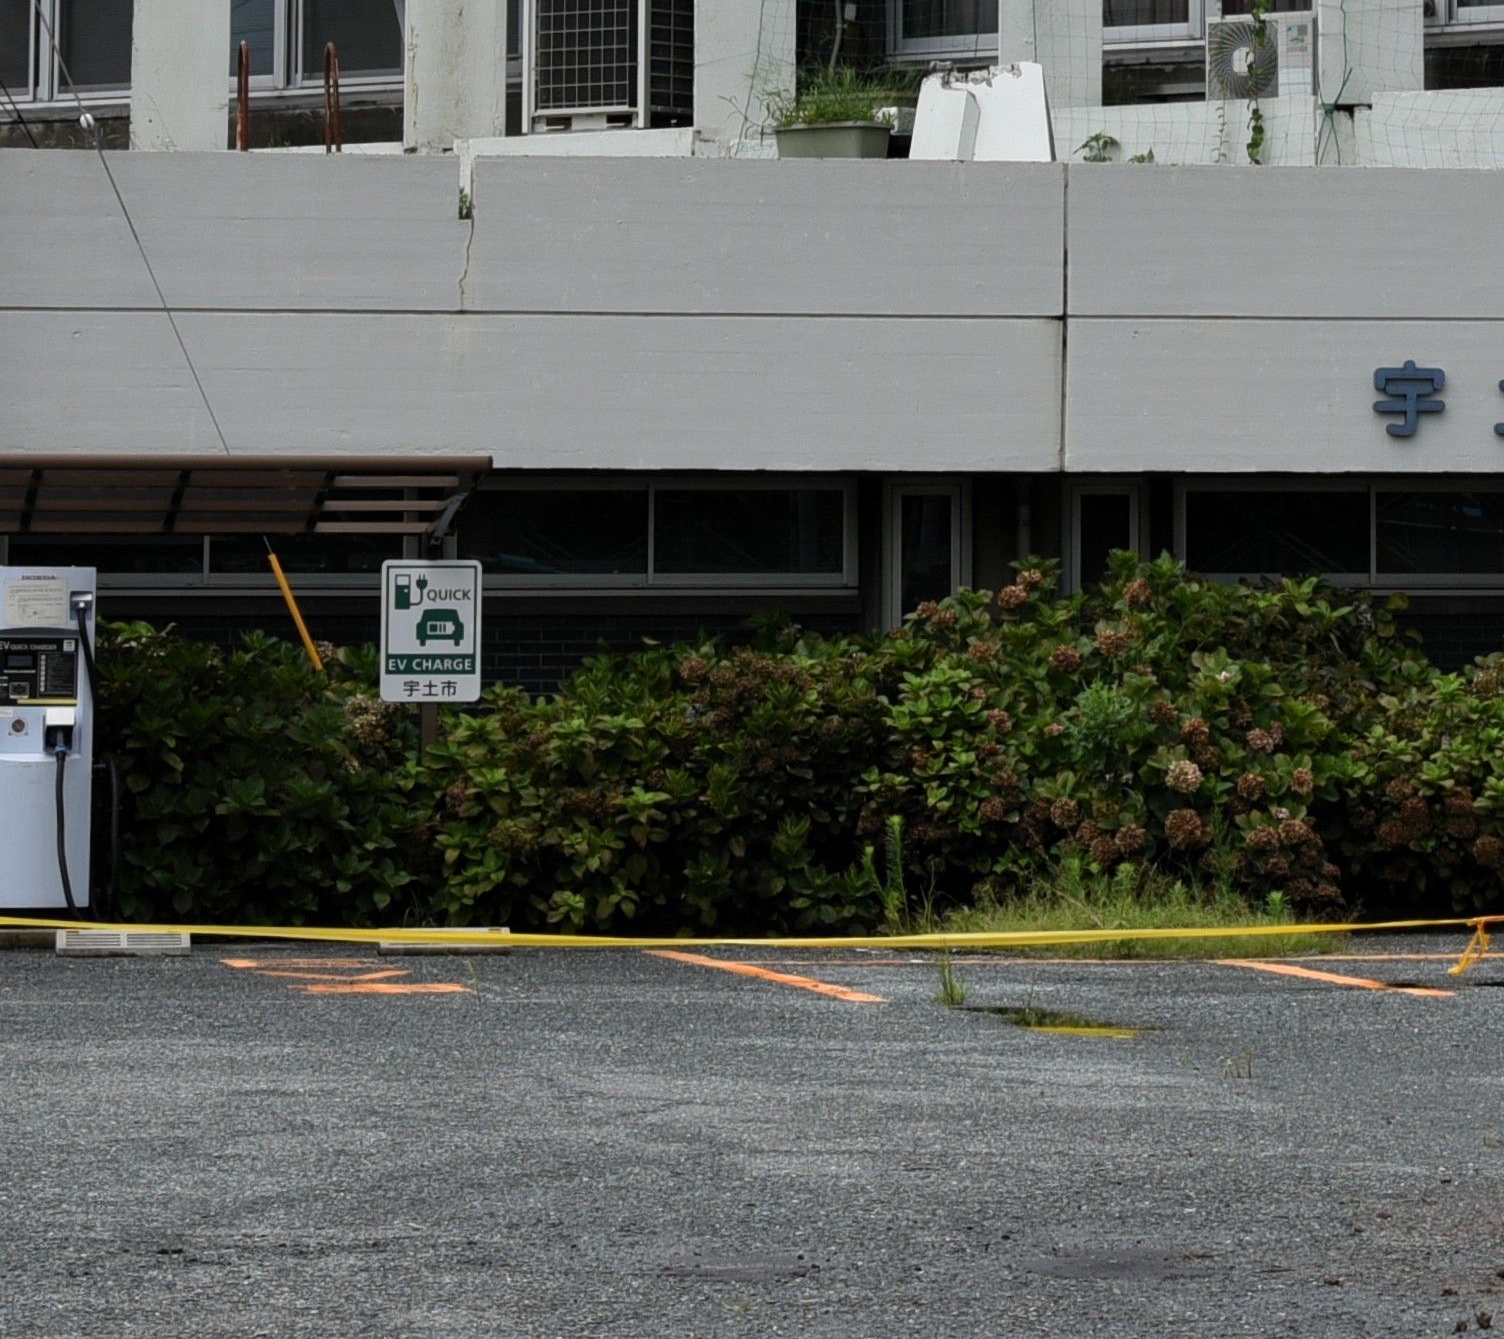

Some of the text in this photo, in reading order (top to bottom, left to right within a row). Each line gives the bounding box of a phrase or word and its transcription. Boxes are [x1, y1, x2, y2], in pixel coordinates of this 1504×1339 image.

[426, 588, 472, 602] QUICK
[388, 658, 472, 671] EV CHARGE
[402, 680, 458, 697] 宇土市
